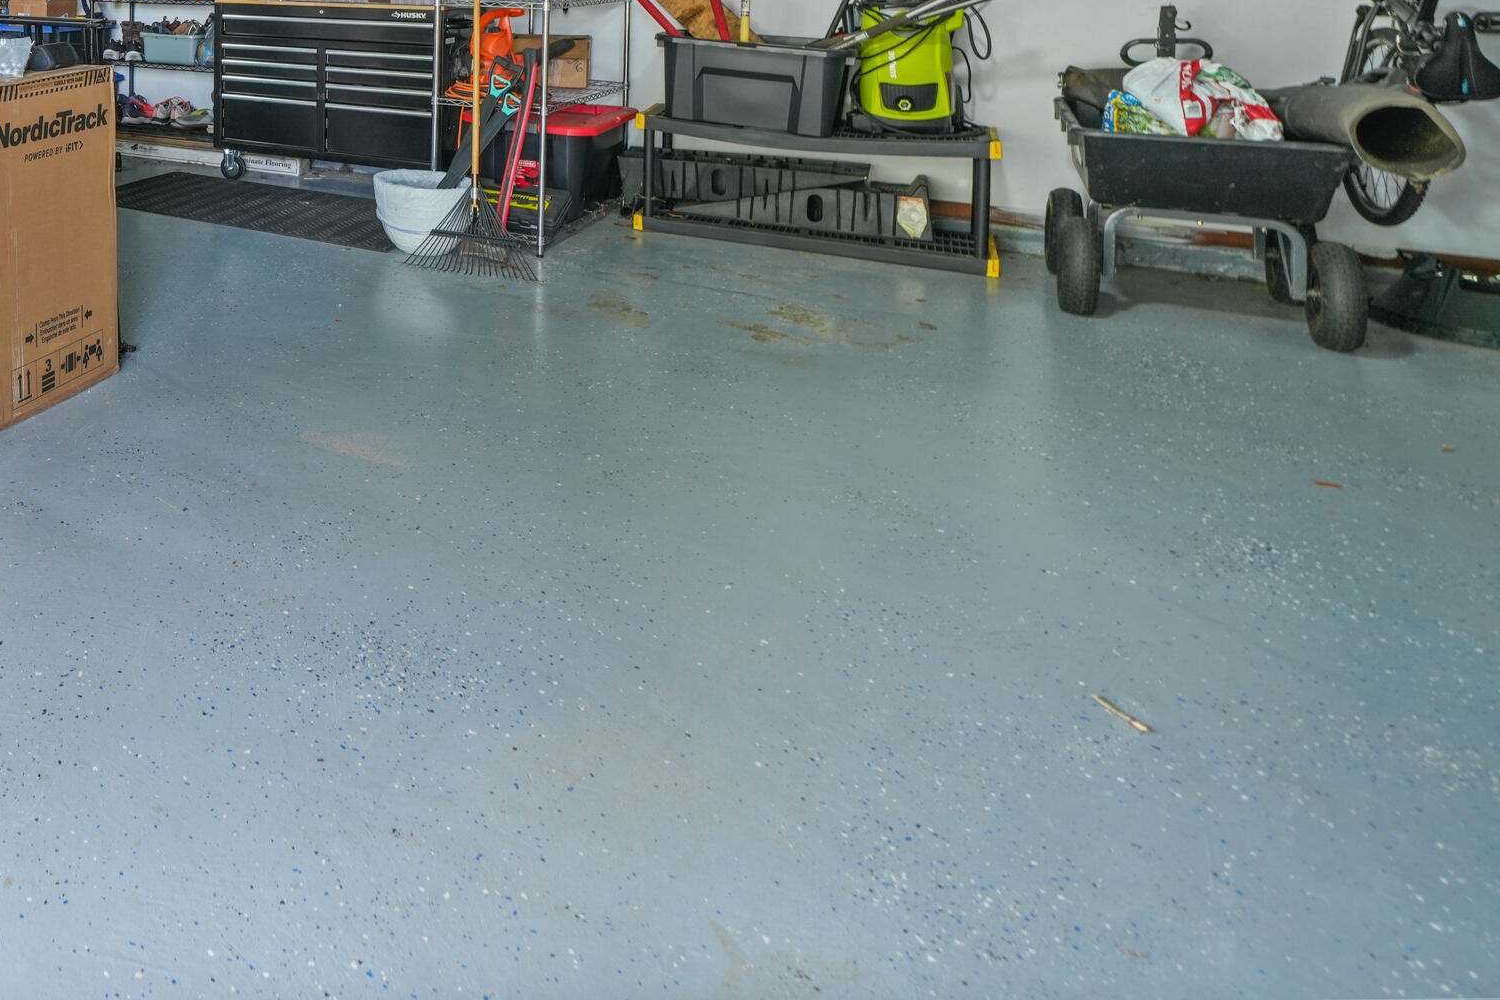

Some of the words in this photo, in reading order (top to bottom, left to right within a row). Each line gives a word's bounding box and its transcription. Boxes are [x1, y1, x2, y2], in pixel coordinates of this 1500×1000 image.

[25, 149, 53, 163] POWERED
[55, 147, 63, 155] BY
[265, 159, 292, 169] Flooring
[45, 359, 52, 372] 3
